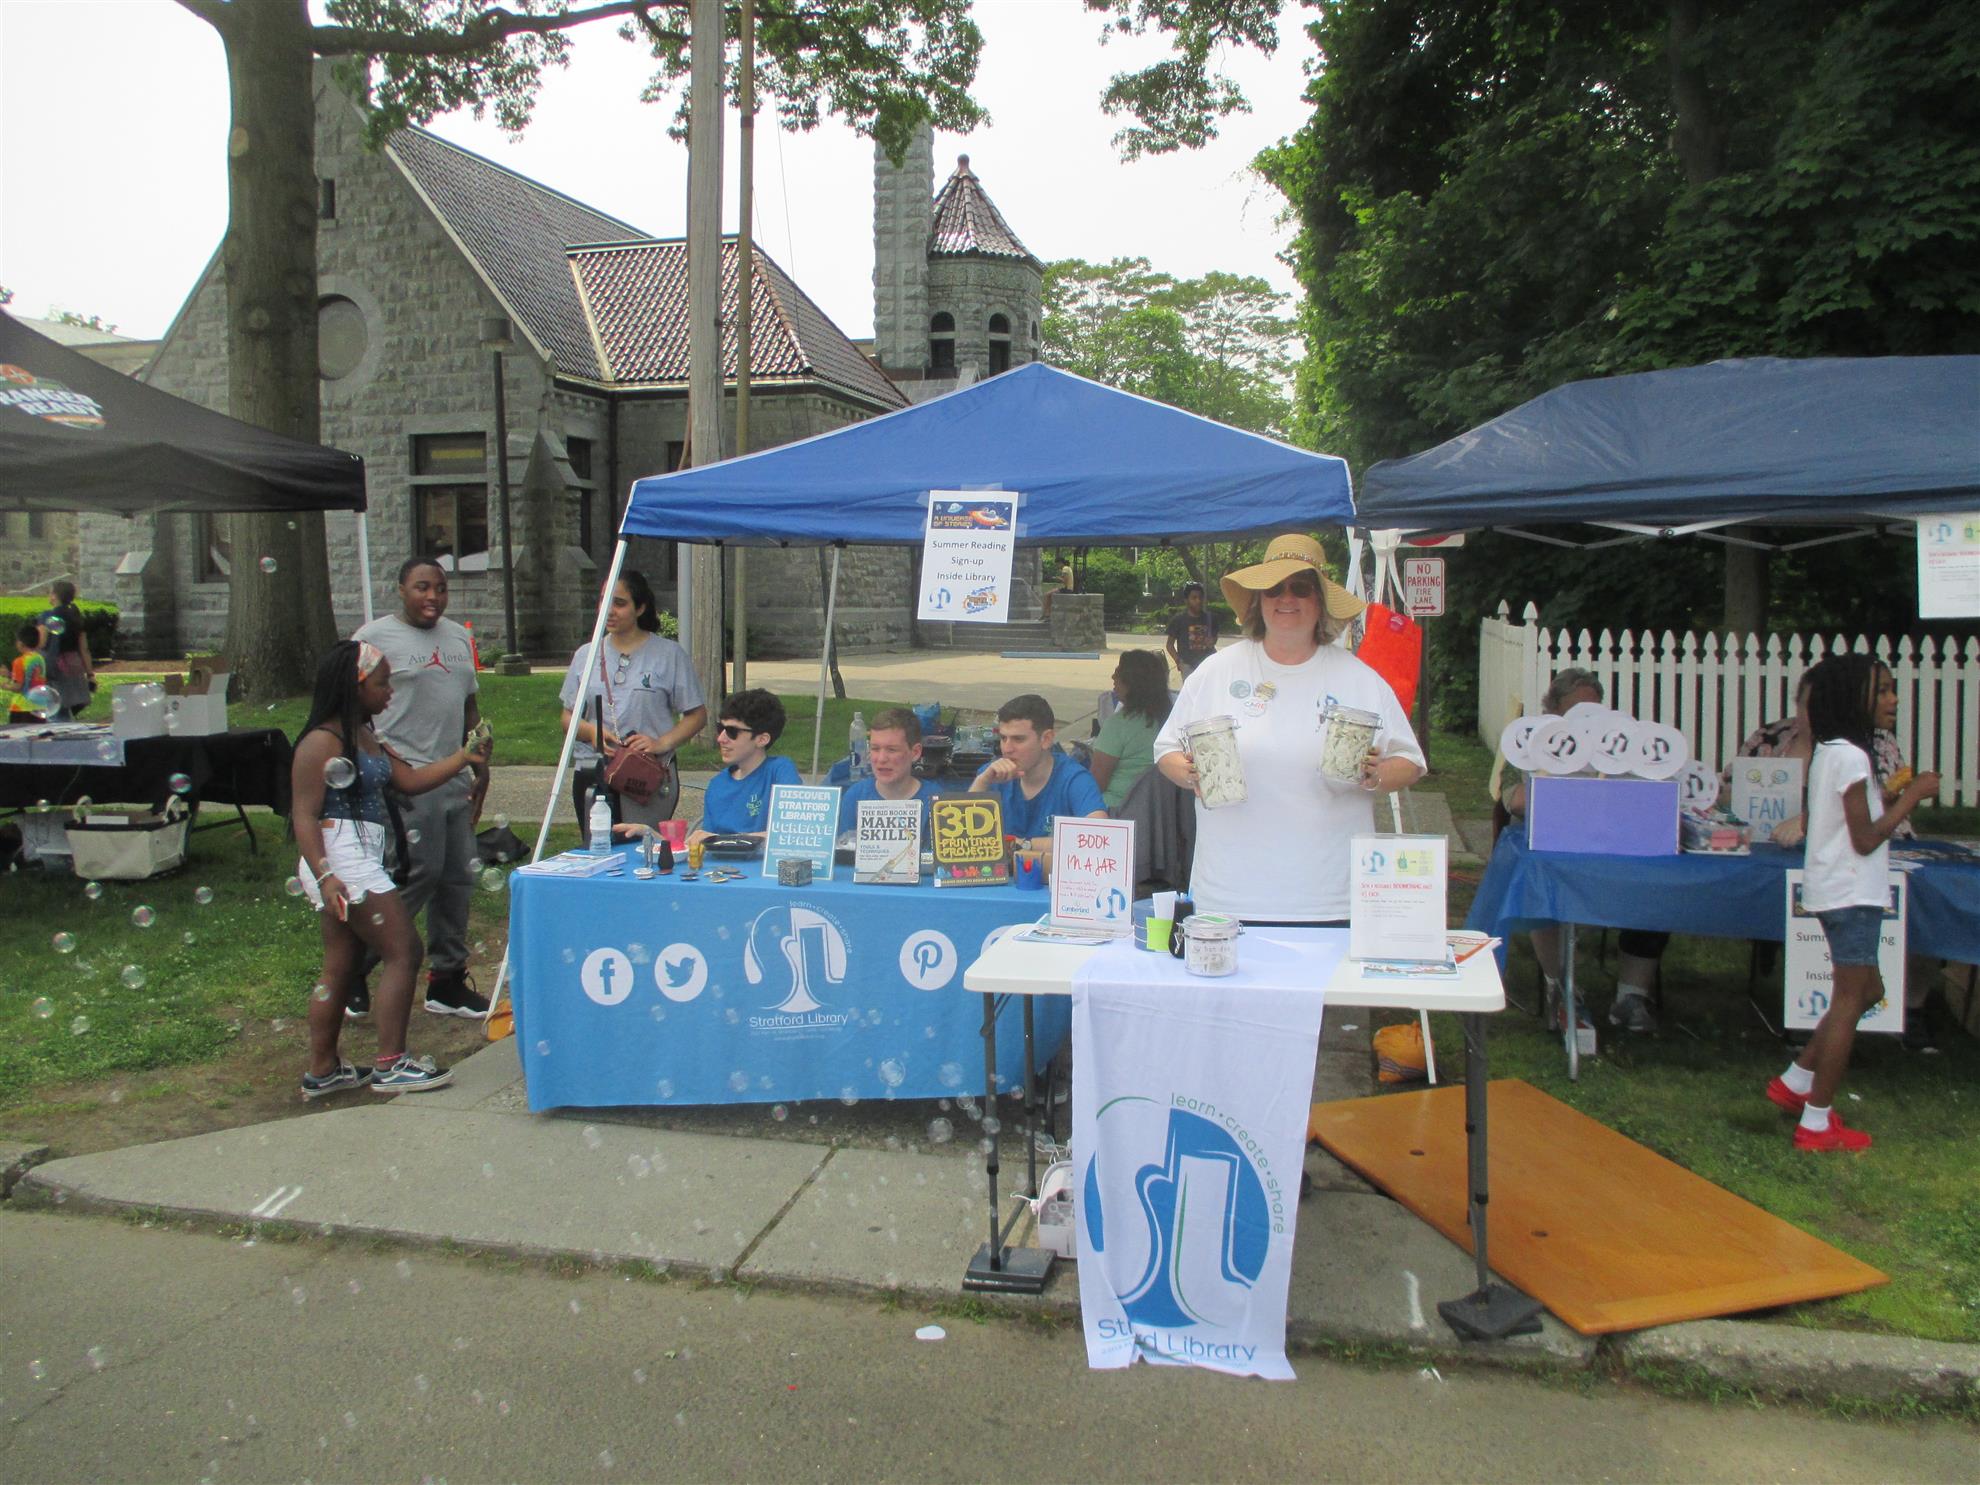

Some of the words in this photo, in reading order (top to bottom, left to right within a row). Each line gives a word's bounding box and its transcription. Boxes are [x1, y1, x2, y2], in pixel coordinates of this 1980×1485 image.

[932, 540, 968, 549] Summer
[971, 541, 1007, 552] Reading
[951, 556, 984, 566] Sign-up
[1416, 563, 1432, 575] NO
[937, 572, 963, 581] Inside
[965, 572, 996, 583] Library
[1407, 575, 1441, 587] PARKING
[1416, 587, 1432, 596] FIRE
[1414, 596, 1433, 605] LANE
[408, 654, 427, 665] Air
[780, 790, 831, 801] DISCOVER
[778, 800, 830, 812] STRATFORD
[1749, 796, 1785, 820] FAN
[780, 810, 825, 821] LIBRARY'S
[860, 816, 918, 828] MAKER
[941, 806, 995, 838] 3D
[778, 834, 823, 847] SPACE
[860, 829, 917, 841] SKILLS
[1077, 833, 1111, 849] BOOK
[942, 837, 996, 848] PRINTING
[942, 847, 997, 857] PROJECTS
[1067, 854, 1081, 871] IN
[1084, 856, 1092, 872] A
[1094, 857, 1118, 876] JAR
[748, 1013, 804, 1028] Stratford
[807, 1012, 849, 1026] Library
[1167, 1332, 1257, 1361] Library
